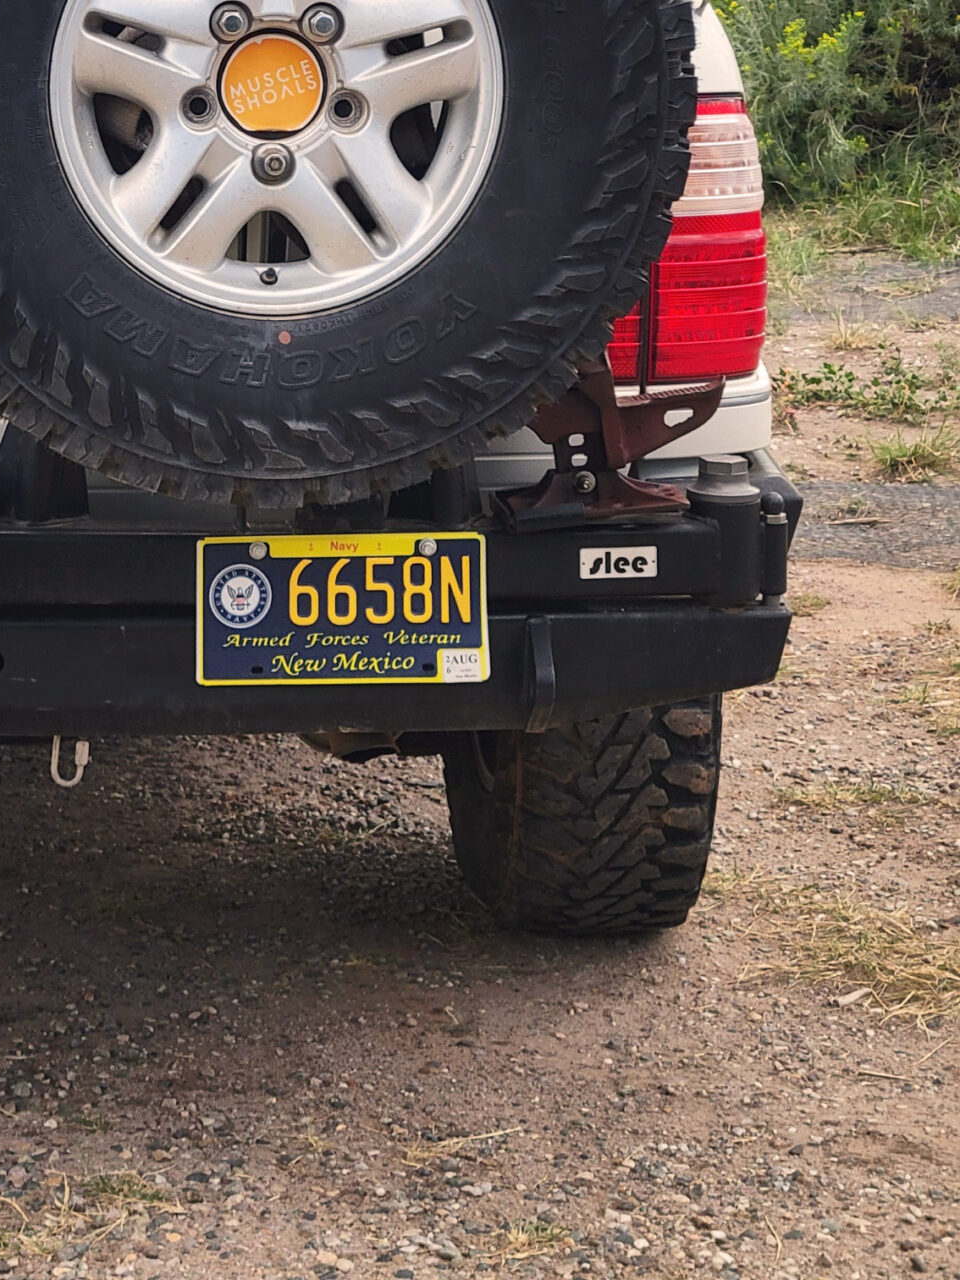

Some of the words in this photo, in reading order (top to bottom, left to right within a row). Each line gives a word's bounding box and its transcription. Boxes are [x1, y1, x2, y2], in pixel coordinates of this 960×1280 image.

[229, 59, 311, 99] MUSCLE
[234, 75, 317, 114] SHOALS
[64, 271, 479, 391] YOKOHAMA
[330, 540, 359, 552] Navy
[589, 551, 648, 575] slee
[288, 554, 472, 627] 6658N
[222, 632, 295, 648] Armed
[305, 632, 369, 648] Forces
[383, 630, 461, 646] Veteran
[271, 654, 327, 676] New
[332, 653, 415, 672] Mexico
[451, 653, 478, 665] AUG
